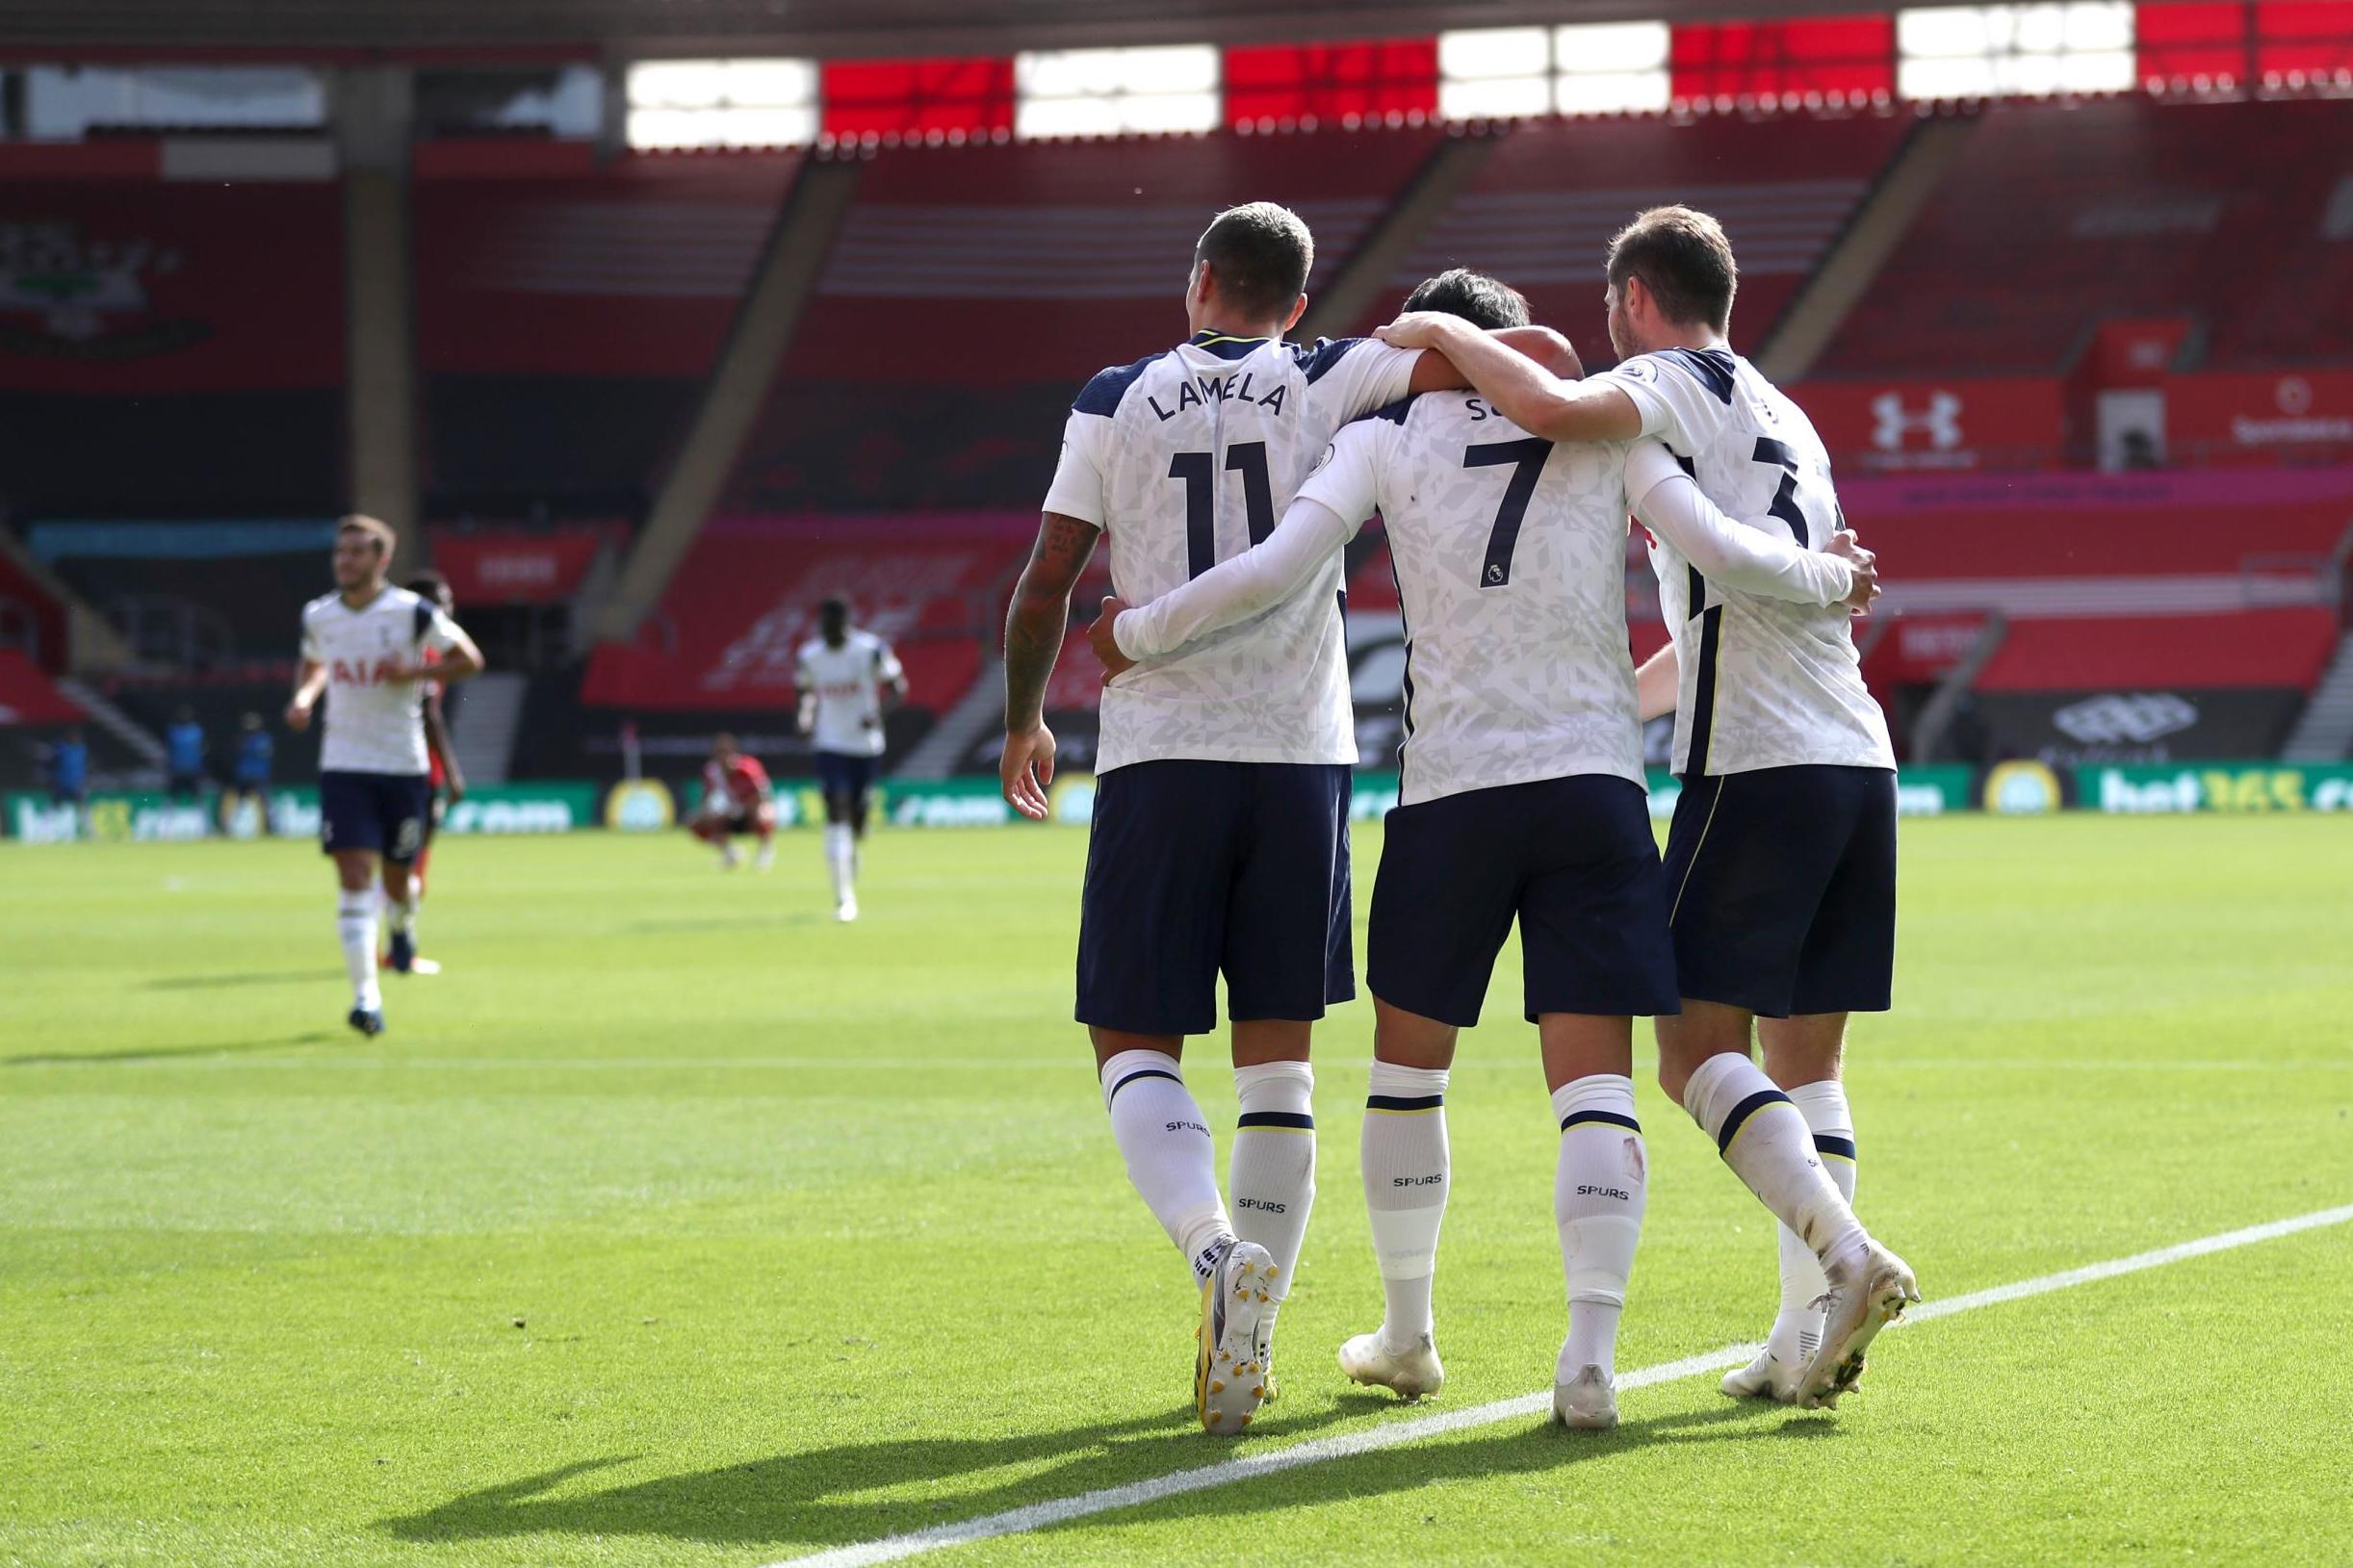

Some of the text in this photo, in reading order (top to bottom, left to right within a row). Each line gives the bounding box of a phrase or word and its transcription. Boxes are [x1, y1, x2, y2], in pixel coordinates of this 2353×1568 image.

[1148, 373, 1286, 422] LAMELA
[1168, 441, 1276, 581] 11
[1462, 436, 1555, 588] 7
[1166, 1120, 1210, 1138] SPURS
[1393, 1173, 1442, 1187] SPURS
[1577, 1185, 1629, 1200] SPURS
[1238, 1197, 1286, 1214] SPURS
